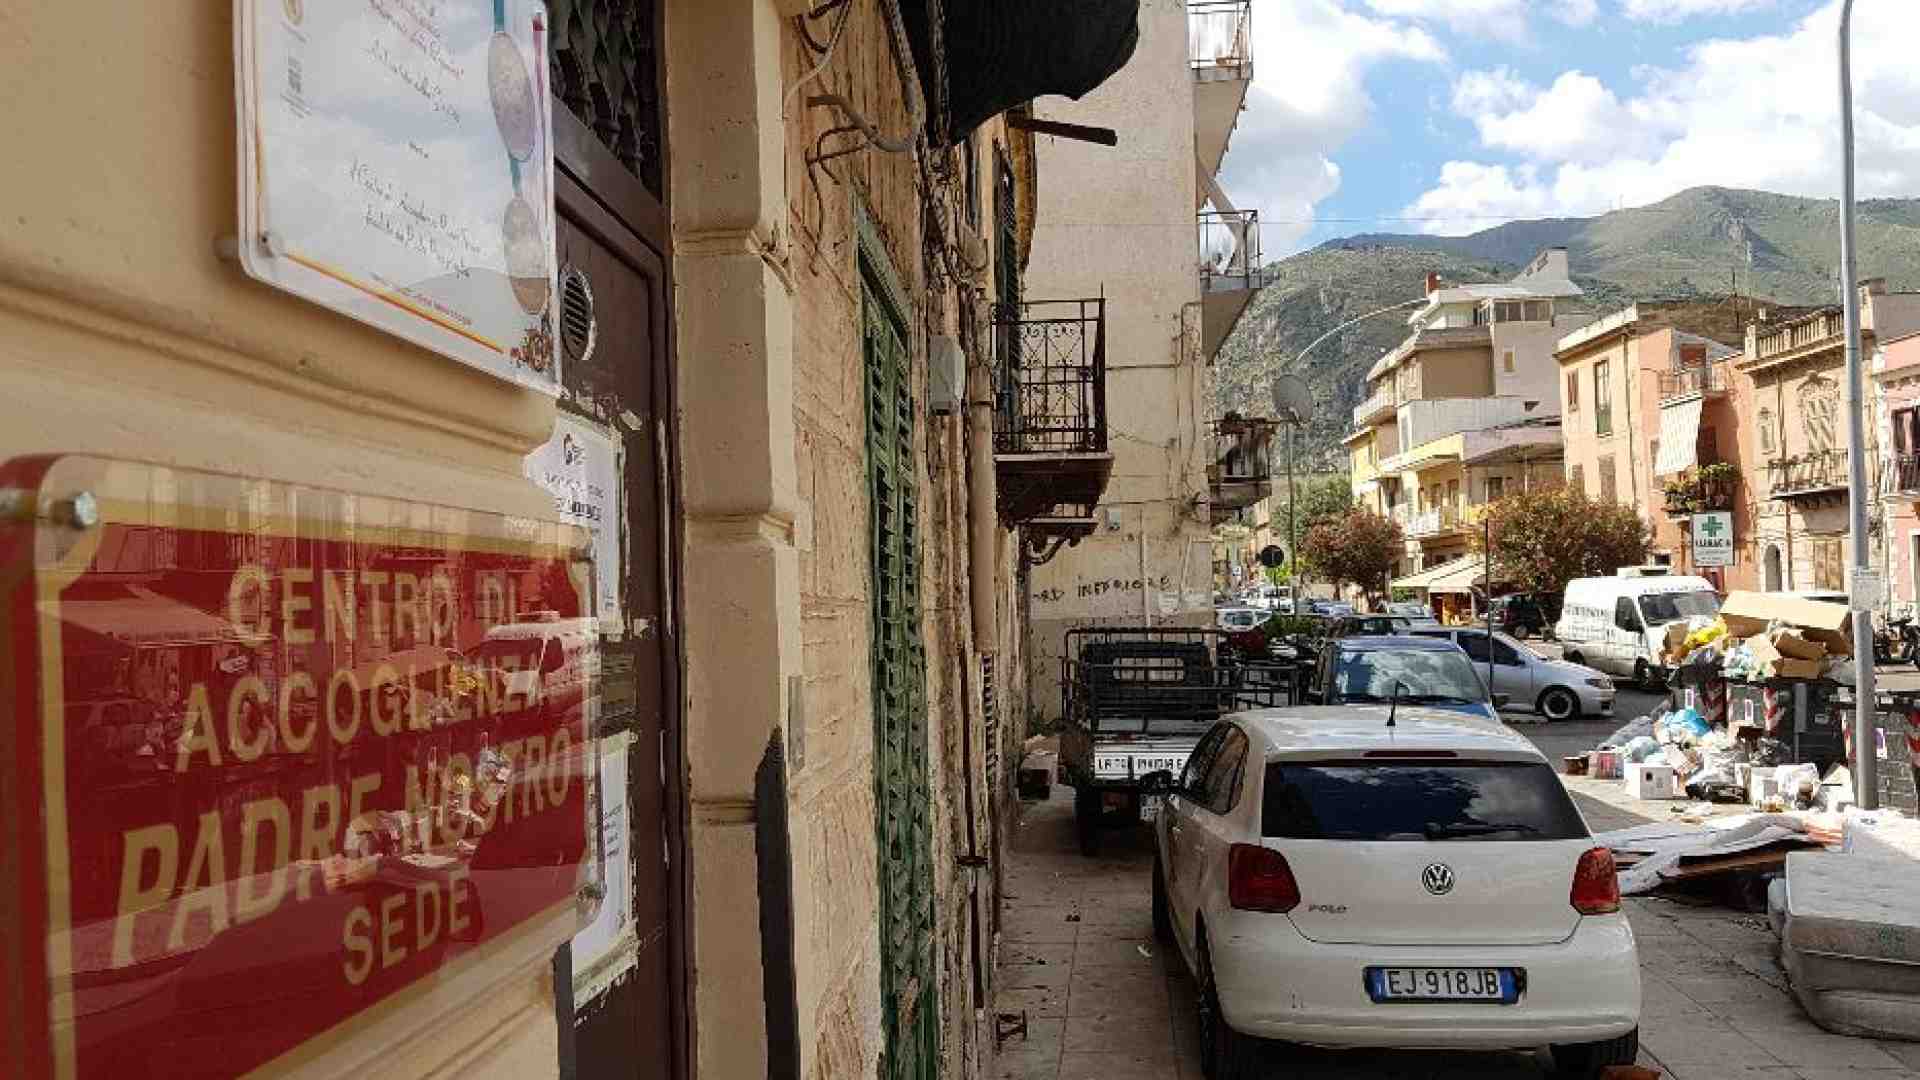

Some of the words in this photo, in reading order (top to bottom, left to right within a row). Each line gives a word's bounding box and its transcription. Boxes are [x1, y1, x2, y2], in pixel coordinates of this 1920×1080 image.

[229, 564, 454, 647] CENTRO
[475, 568, 517, 629] DI
[175, 652, 544, 772] ACCOGLIENZA
[112, 772, 382, 970] PADRE
[342, 868, 472, 986] SEDE
